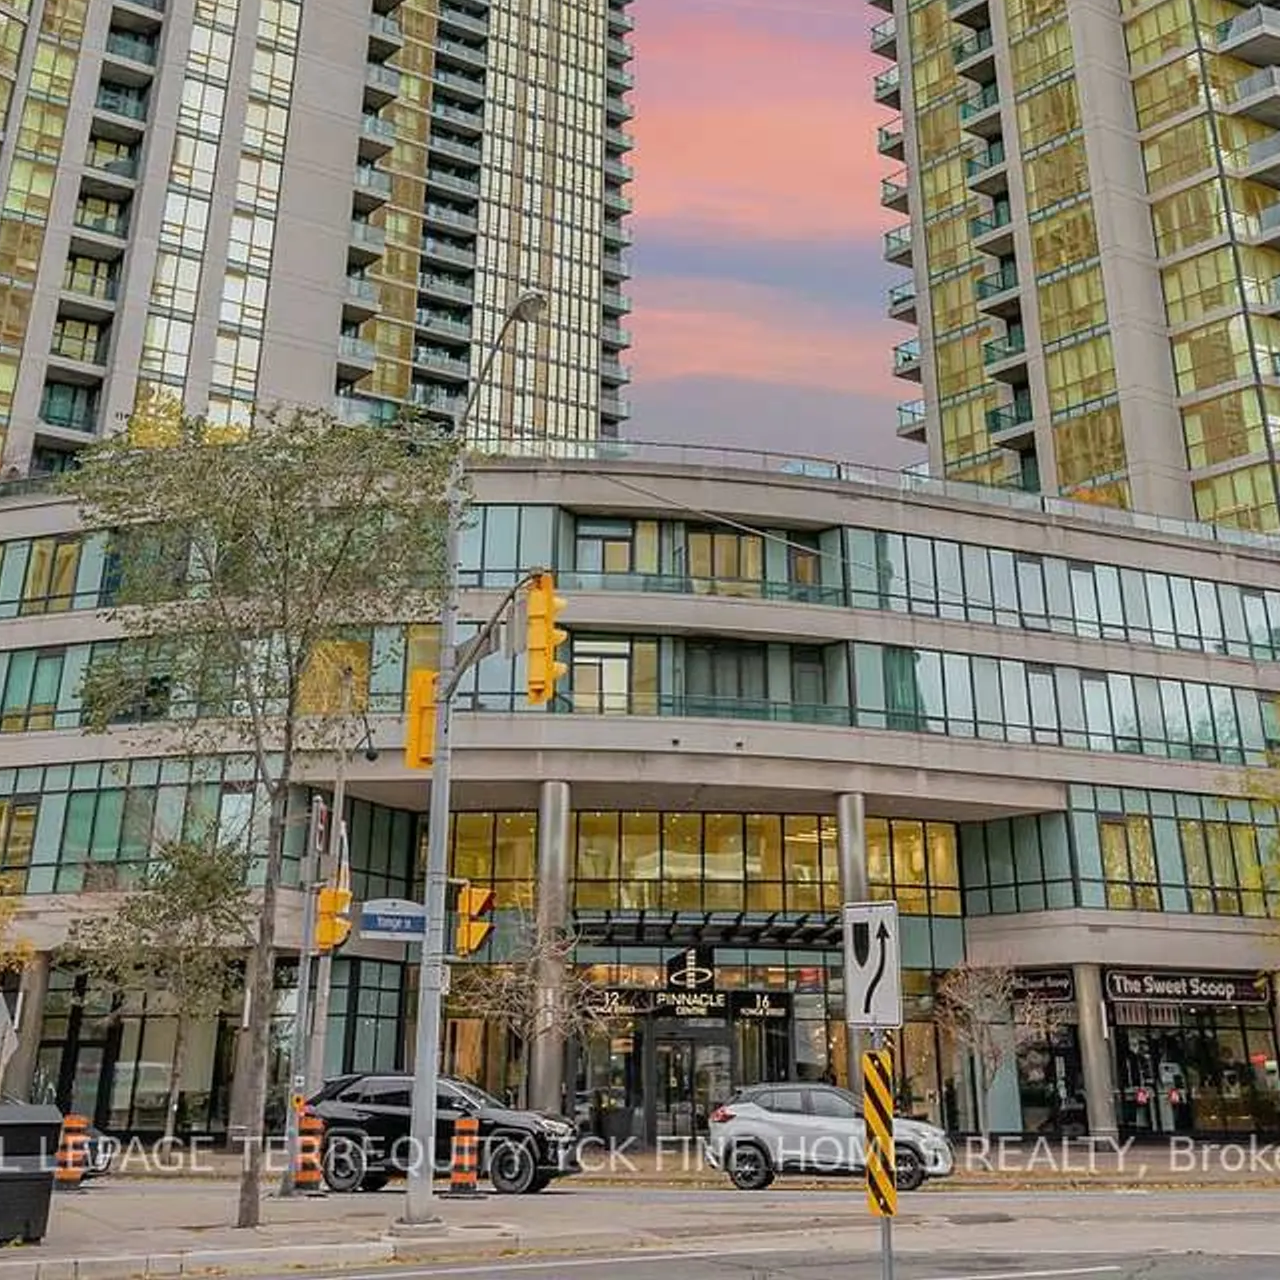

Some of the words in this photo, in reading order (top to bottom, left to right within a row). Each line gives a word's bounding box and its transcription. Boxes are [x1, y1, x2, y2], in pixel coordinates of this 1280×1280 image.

[1113, 974, 1142, 993] The
[1145, 975, 1188, 996] Sweet
[1191, 979, 1236, 1000] Scoop
[604, 991, 620, 1008] 12
[655, 992, 726, 1008] PINNACLE
[755, 993, 770, 1009] 16
